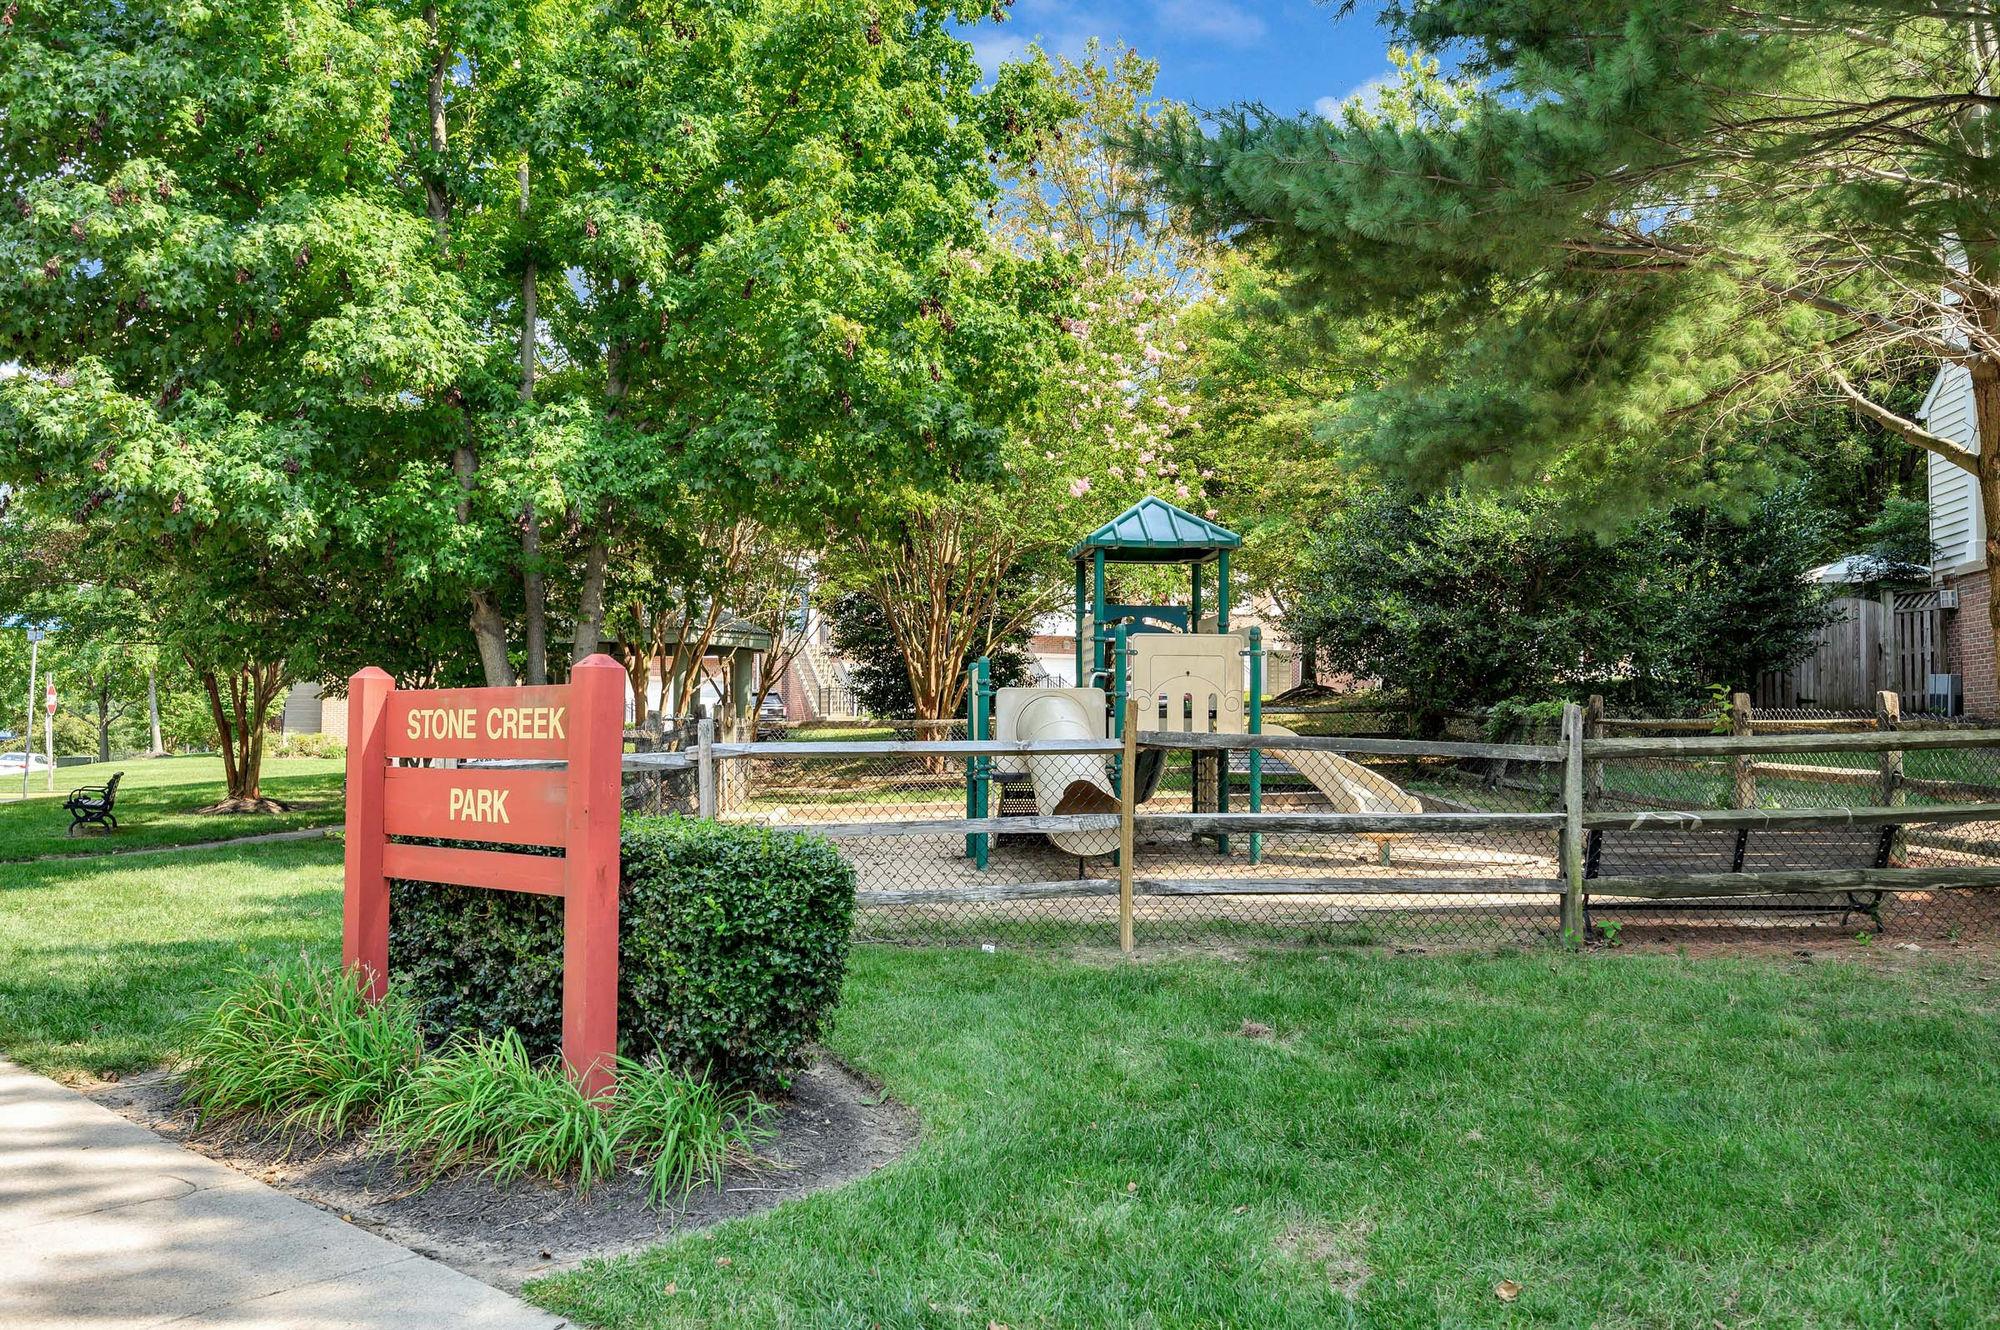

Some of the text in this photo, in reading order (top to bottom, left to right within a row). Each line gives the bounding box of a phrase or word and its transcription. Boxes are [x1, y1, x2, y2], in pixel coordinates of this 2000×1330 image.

[407, 707, 565, 740] STONE CREEK
[449, 788, 510, 824] PARK
